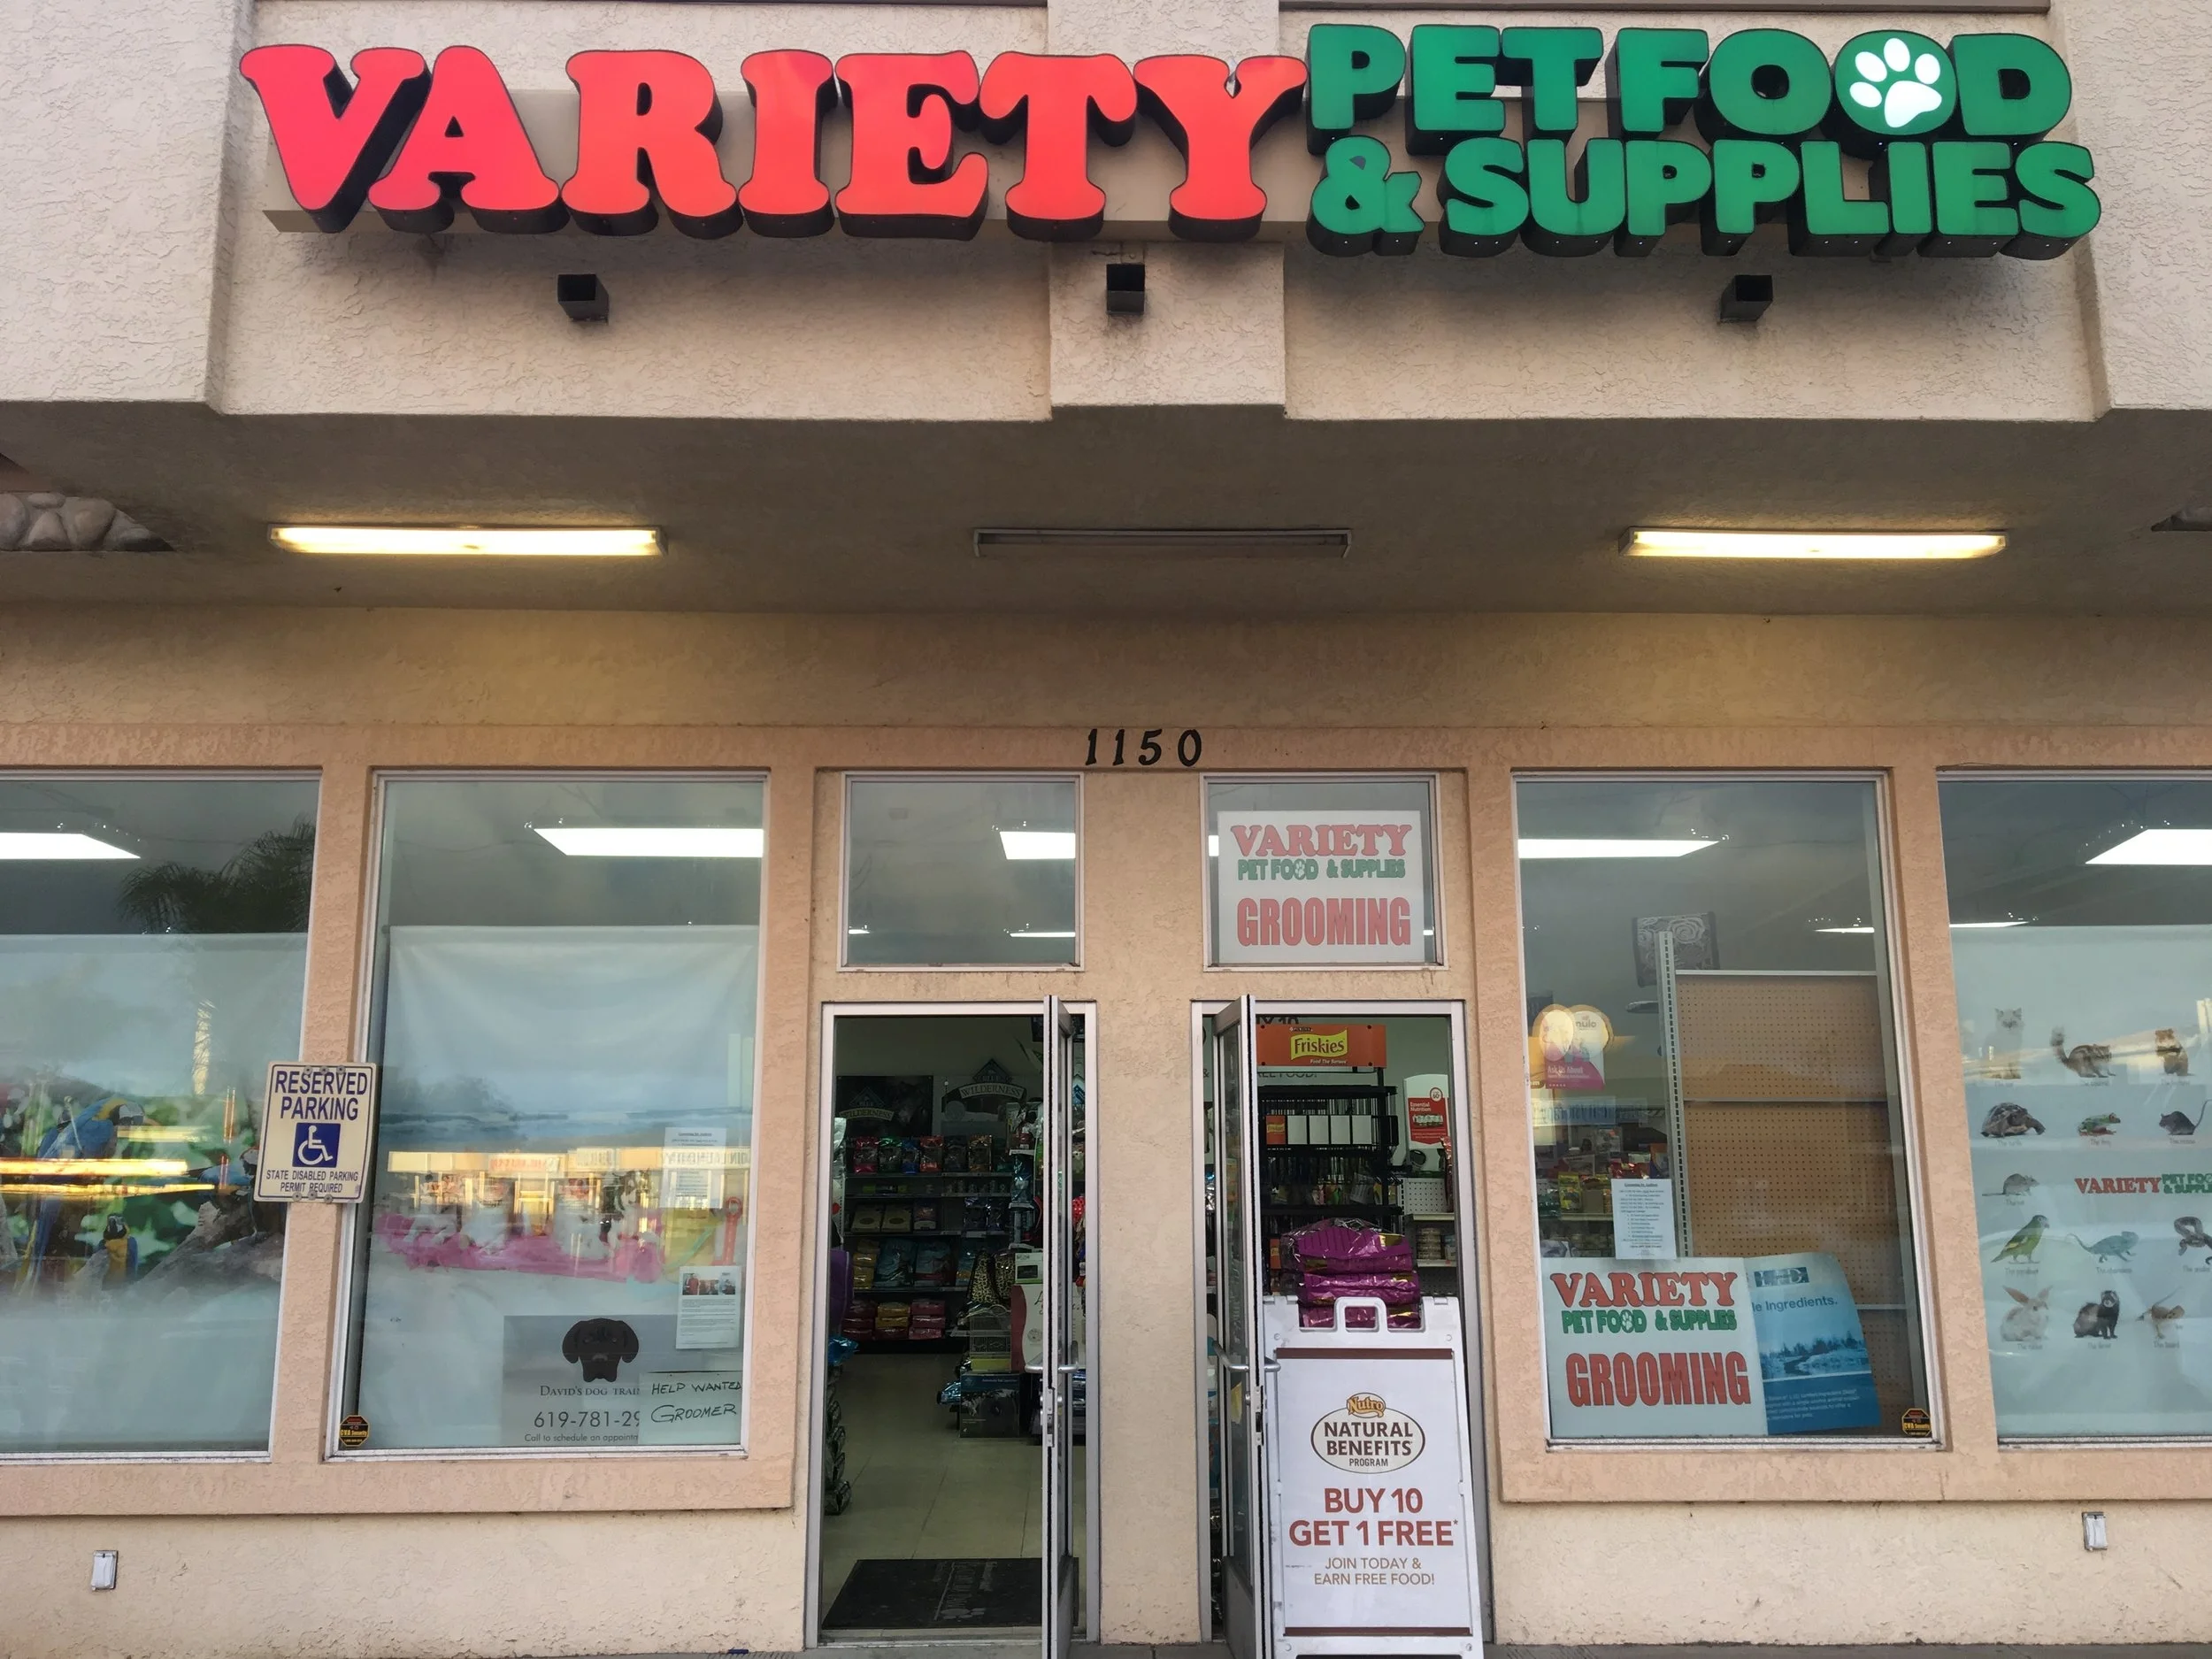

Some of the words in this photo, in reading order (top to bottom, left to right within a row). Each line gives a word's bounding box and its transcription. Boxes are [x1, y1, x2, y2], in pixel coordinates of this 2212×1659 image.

[1307, 24, 1603, 142] PET
[1617, 27, 2072, 146] FOOD
[240, 43, 1308, 230] VARIETY
[1310, 135, 1423, 243] &
[1442, 137, 2101, 246] SUPPLIES
[1085, 728, 1202, 767] 1150
[1230, 824, 1413, 857] VARIETY
[1238, 858, 1268, 880] PET
[1271, 858, 1318, 880] FOOD
[1326, 858, 1338, 879] &
[1340, 858, 1406, 879] SUPPLIES
[1236, 897, 1411, 947] GROOMING
[1294, 1037, 1345, 1054] Friskies
[274, 1071, 368, 1094] RESERVED
[961, 1084, 1021, 1096] WILDERNESS
[280, 1096, 359, 1121] PARKING
[265, 1170, 288, 1180] STATE
[292, 1170, 326, 1181] DISABLED
[329, 1171, 358, 1181] PARKING
[2075, 1177, 2162, 1194] VARIETY
[2162, 1174, 2185, 1184] PET
[2186, 1173, 2212, 1184] FOO
[280, 1182, 305, 1193] PERMIT
[310, 1183, 343, 1194] REQUIRED
[1550, 1271, 1738, 1308] VARIETY
[1765, 1295, 1838, 1312] Ingredients.
[1561, 1310, 1594, 1333] PET
[1596, 1309, 1647, 1333] FOOD
[1655, 1310, 1669, 1331] &
[1669, 1309, 1738, 1331] SUPPLIES
[651, 1382, 686, 1395] HELP
[691, 1381, 741, 1393] WANTED
[1565, 1351, 1752, 1408] GROOMING
[650, 1403, 737, 1423] GROOMER
[1346, 1395, 1386, 1417] Nutro
[524, 1433, 541, 1442] Call
[543, 1433, 550, 1442] to
[553, 1433, 588, 1442] schedule
[1324, 1422, 1413, 1438] NATURAL
[1326, 1440, 1412, 1456] BENEFITS
[1348, 1458, 1389, 1467] PROGRAM
[1324, 1487, 1386, 1514] BUY
[1391, 1487, 1424, 1514] 10
[1288, 1519, 1349, 1547] GET
[1356, 1520, 1370, 1547] 1
[1325, 1557, 1357, 1570] JOIN
[1361, 1557, 1408, 1570] TODAY
[1411, 1557, 1422, 1570] &
[1314, 1573, 1351, 1586] EARN
[1355, 1573, 1386, 1586] FREE
[1391, 1573, 1435, 1586] FOOD!
